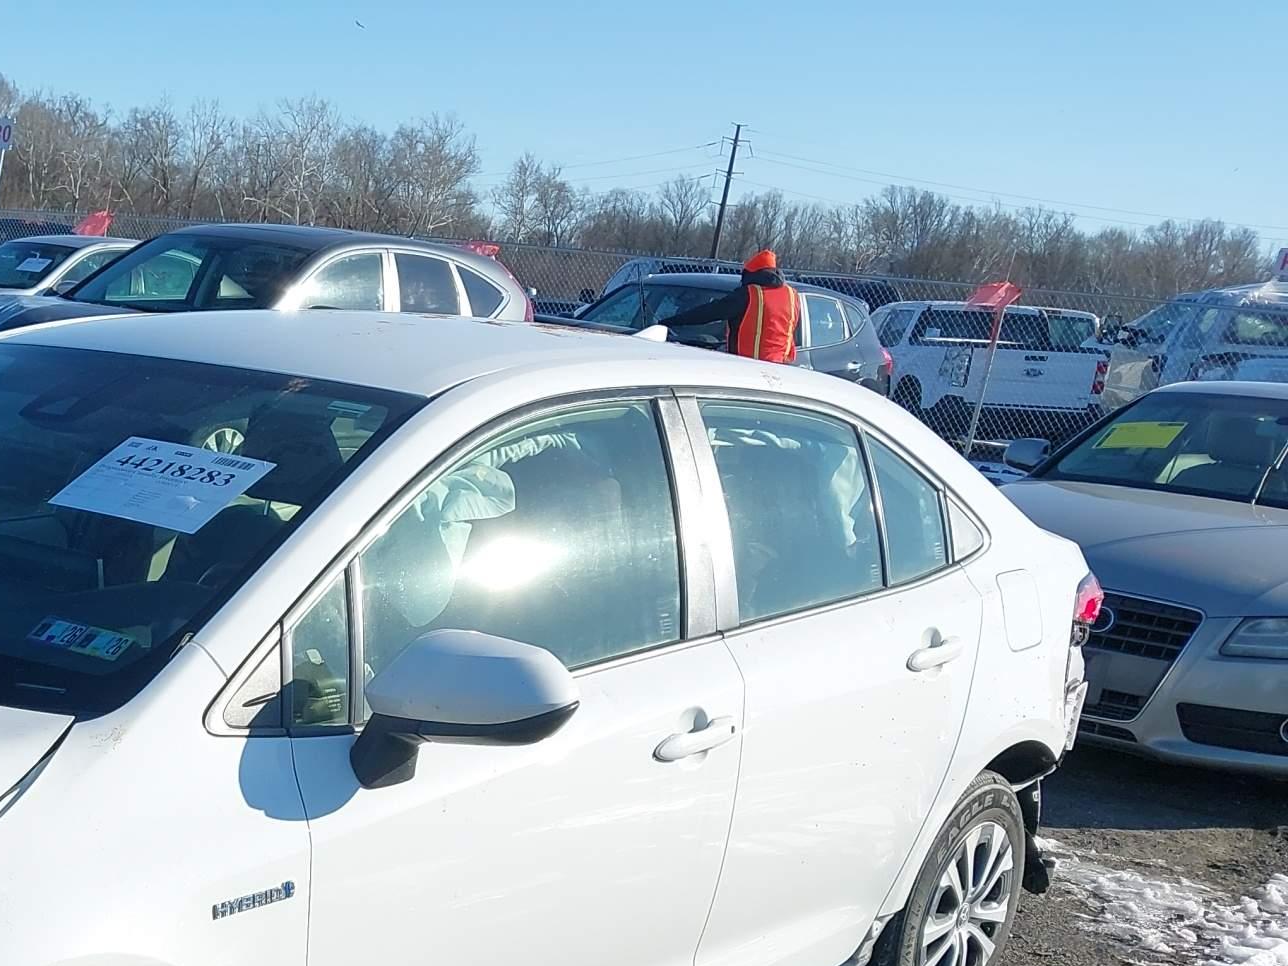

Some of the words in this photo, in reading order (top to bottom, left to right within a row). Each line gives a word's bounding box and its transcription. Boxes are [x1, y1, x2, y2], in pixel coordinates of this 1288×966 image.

[116, 454, 236, 488] 44218283
[937, 793, 994, 865] EAGLE
[212, 886, 282, 920] HYBRID
